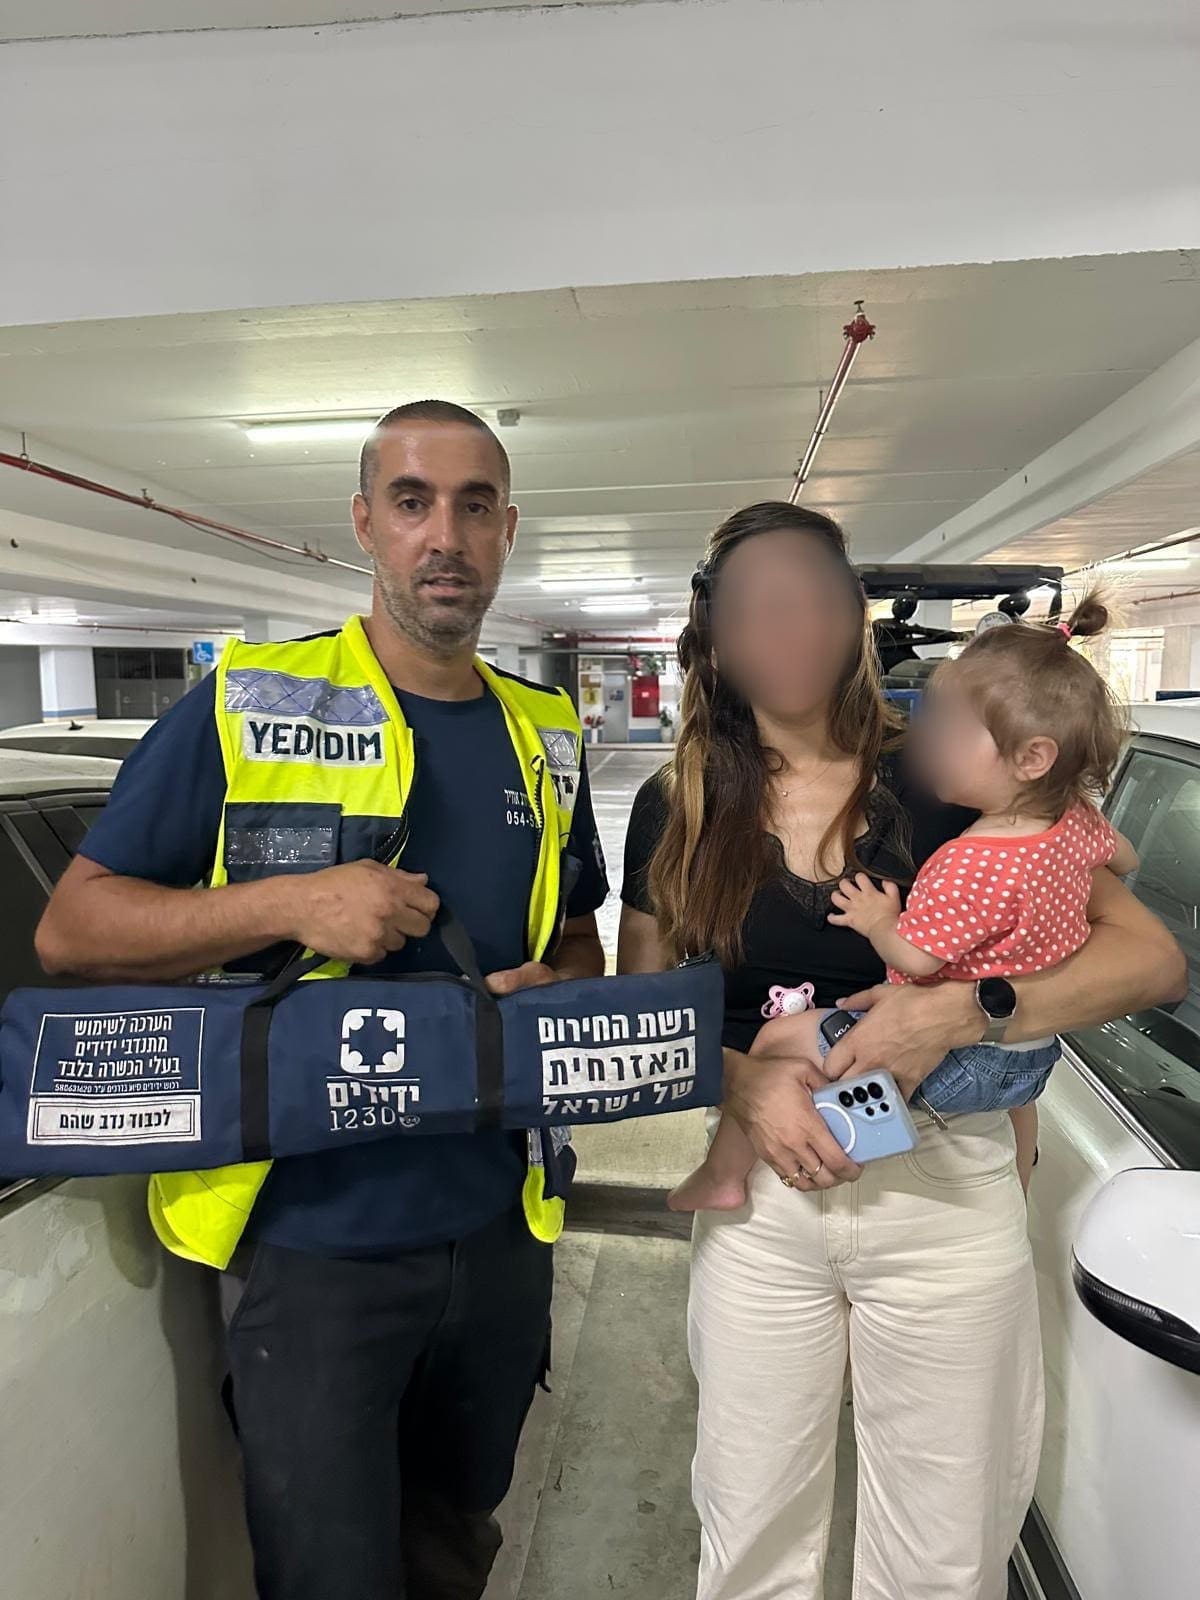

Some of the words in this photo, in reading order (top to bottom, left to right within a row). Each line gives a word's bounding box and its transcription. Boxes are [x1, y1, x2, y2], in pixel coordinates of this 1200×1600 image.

[249, 720, 382, 761] YEDIDIM
[74, 1016, 126, 1036] לשימוש
[129, 1014, 172, 1033] הערכה
[538, 1014, 630, 1044] החירום
[637, 1007, 696, 1038] רשת
[75, 1039, 117, 1057] ידידים
[121, 1036, 168, 1055] מתנדבי
[58, 1058, 94, 1078] בלבד
[98, 1059, 143, 1078] הכשרה
[149, 1055, 181, 1075] בעלי
[549, 1047, 689, 1086] האזרחית
[326, 1082, 420, 1113] ידידים
[653, 1079, 694, 1105] של
[542, 1091, 641, 1115] ישראל
[59, 1113, 95, 1130] שהם
[99, 1113, 125, 1130] נדב
[129, 1109, 171, 1129] לכבוד
[329, 1106, 396, 1131] 1230
